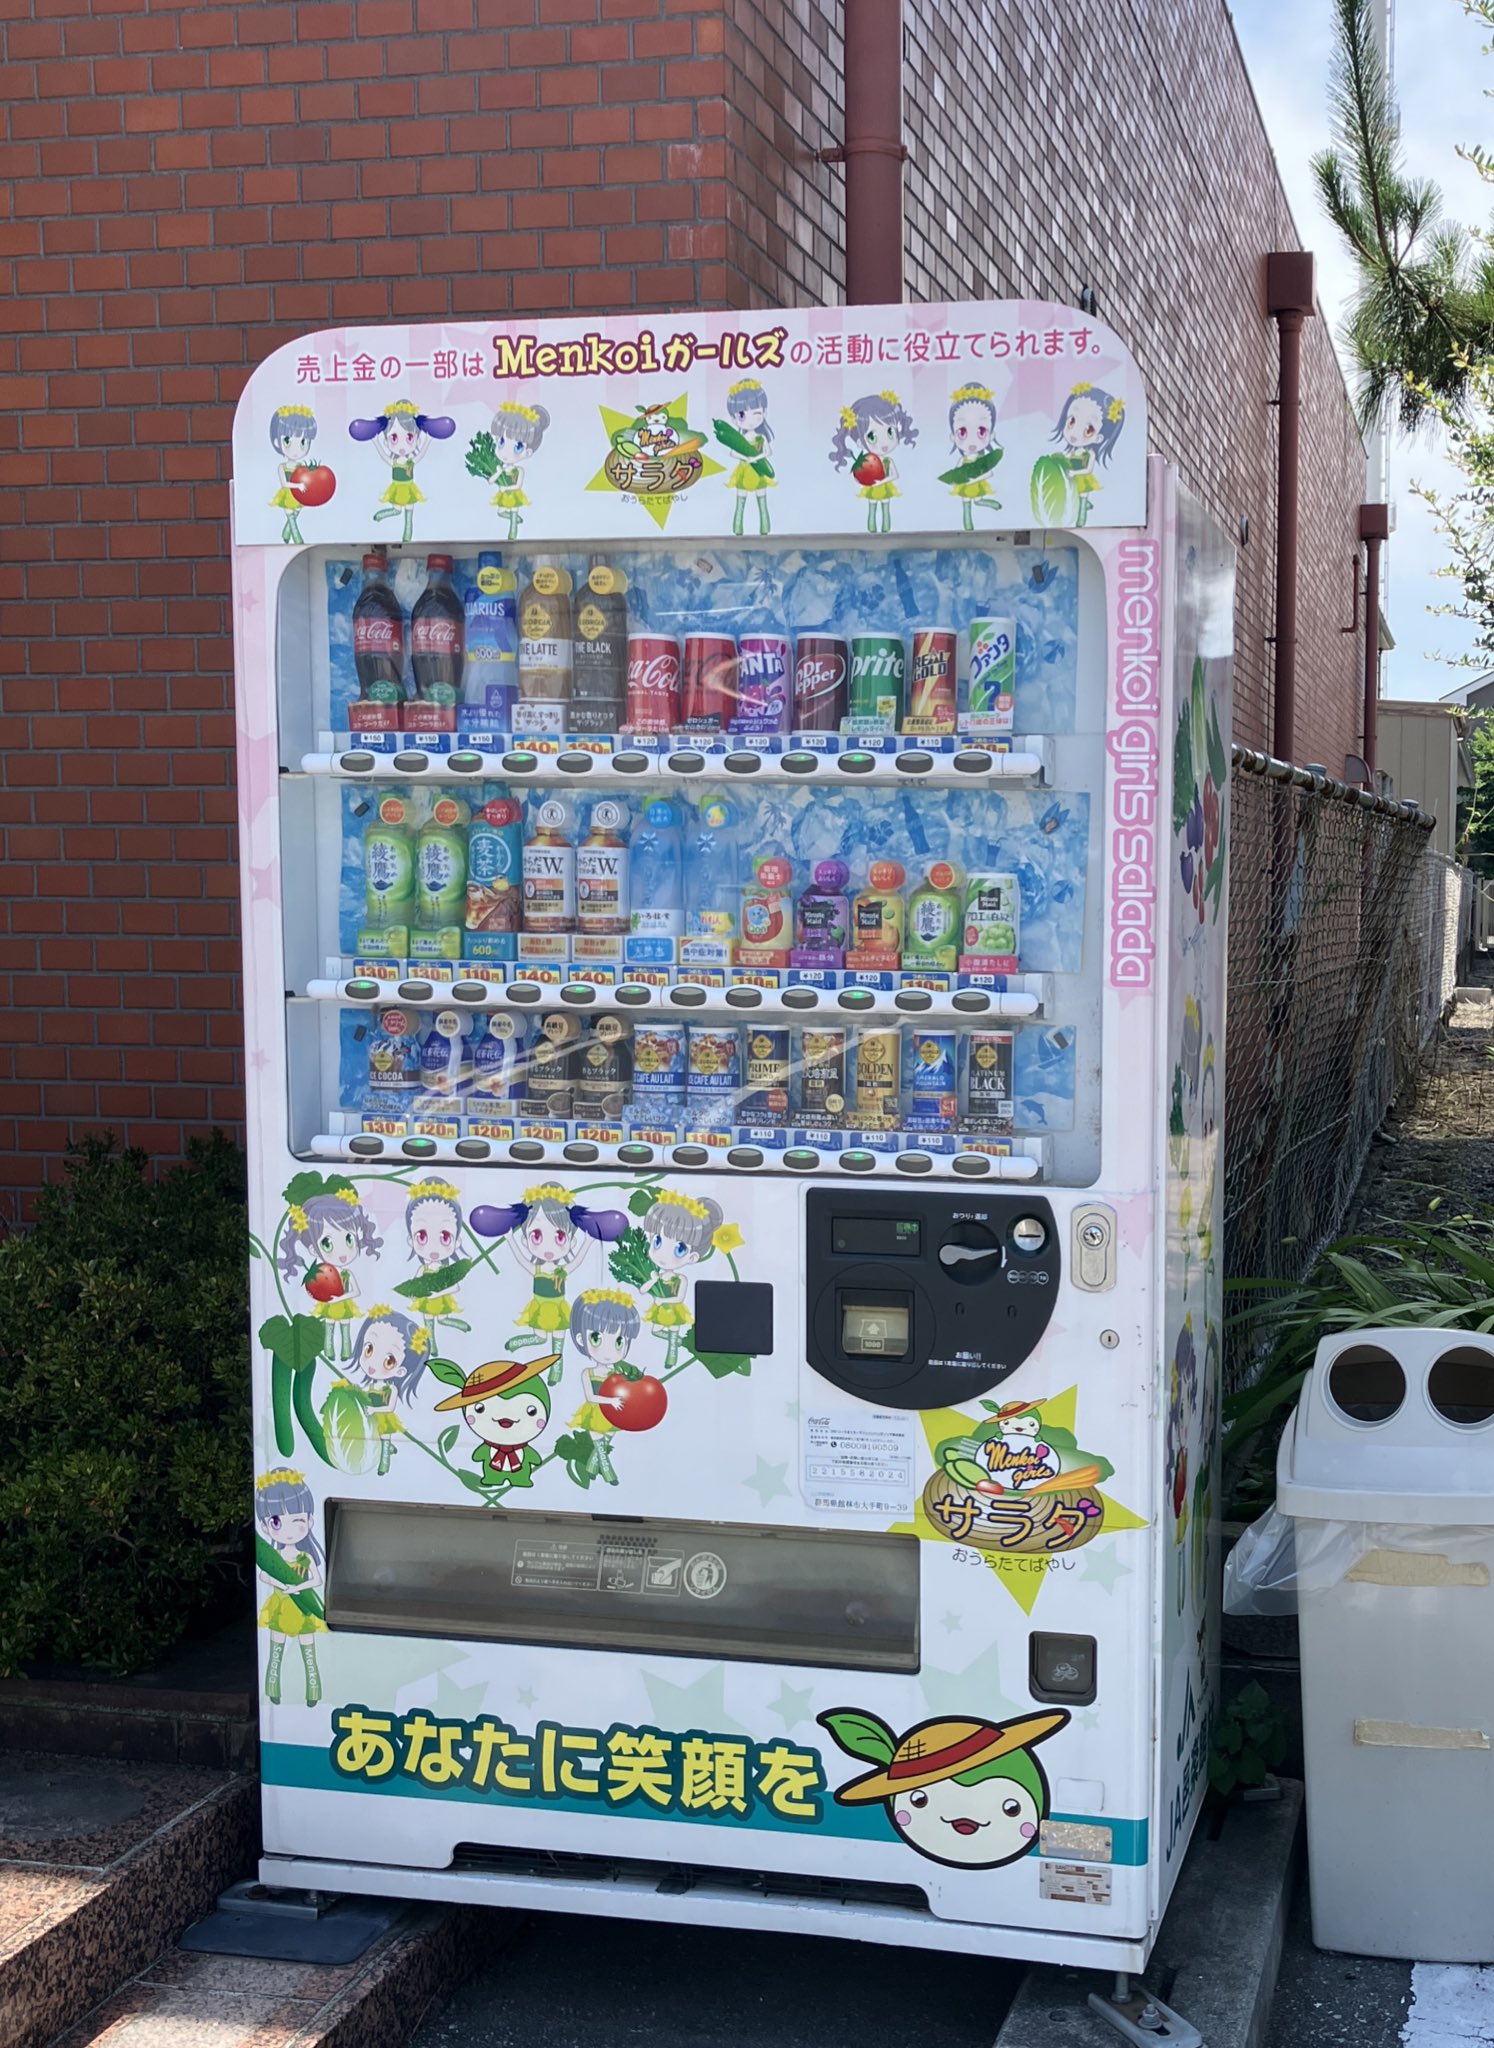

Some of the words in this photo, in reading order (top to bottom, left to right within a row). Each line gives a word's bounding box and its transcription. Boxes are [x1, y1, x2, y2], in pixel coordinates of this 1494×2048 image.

[610, 460, 702, 491] サラダ
[1118, 542, 1159, 714] menkoi
[531, 644, 557, 656] LATTE
[586, 642, 612, 654] BLACK
[915, 651, 949, 668] REAL
[970, 634, 1009, 679] ファンタ
[741, 653, 784, 677] ANTA
[803, 660, 823, 674] Dr
[850, 648, 904, 684] prite
[1108, 721, 1157, 826] girls
[372, 843, 391, 880] 綾鷹
[425, 844, 444, 880] 綾鷹
[477, 838, 493, 876] 麦茶
[921, 901, 935, 933] 綾鷹
[1111, 830, 1156, 986] salada
[861, 918, 876, 926] Maid
[378, 1071, 404, 1081] COCOA
[366, 1123, 405, 1135] 130円
[417, 1124, 455, 1137] 120円
[473, 1126, 511, 1139] 120円
[523, 1127, 563, 1141] 120円
[580, 1128, 619, 1142] 120円
[635, 1131, 672, 1145] 110円
[690, 1133, 728, 1147] 110円
[985, 1440, 1049, 1472] Menkoi
[1012, 1466, 1055, 1489] girls
[934, 1494, 1101, 1550] サラダ
[952, 1548, 1076, 1572] おうらたてばやし
[269, 1645, 282, 1684] Salada
[333, 1705, 823, 1822] あなたに笑顔を
